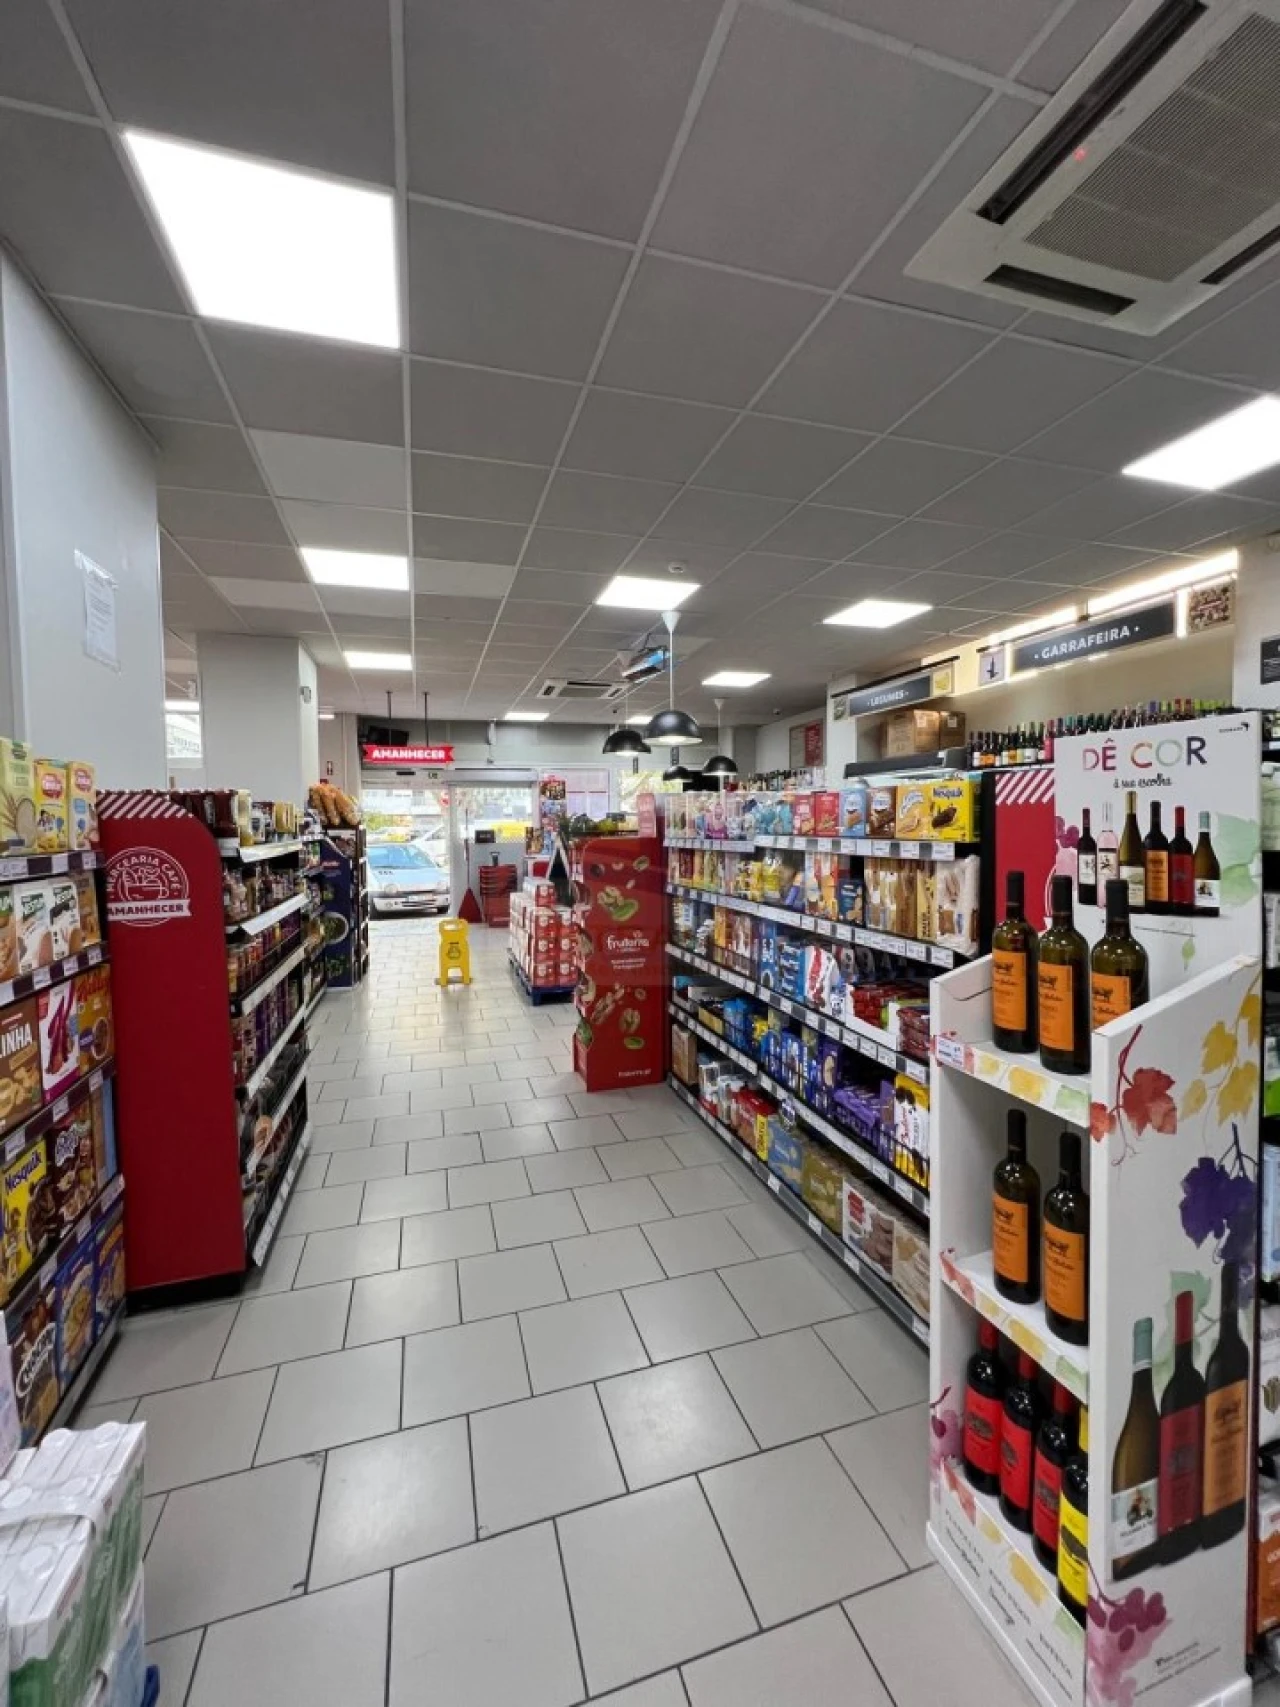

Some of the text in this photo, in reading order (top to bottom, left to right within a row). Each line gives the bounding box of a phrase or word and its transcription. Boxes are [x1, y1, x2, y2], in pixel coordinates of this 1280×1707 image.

[1041, 625, 1131, 659] GARRAFEIRA
[372, 749, 446, 760] AMANHECER
[1082, 736, 1207, 771] DÊ COR
